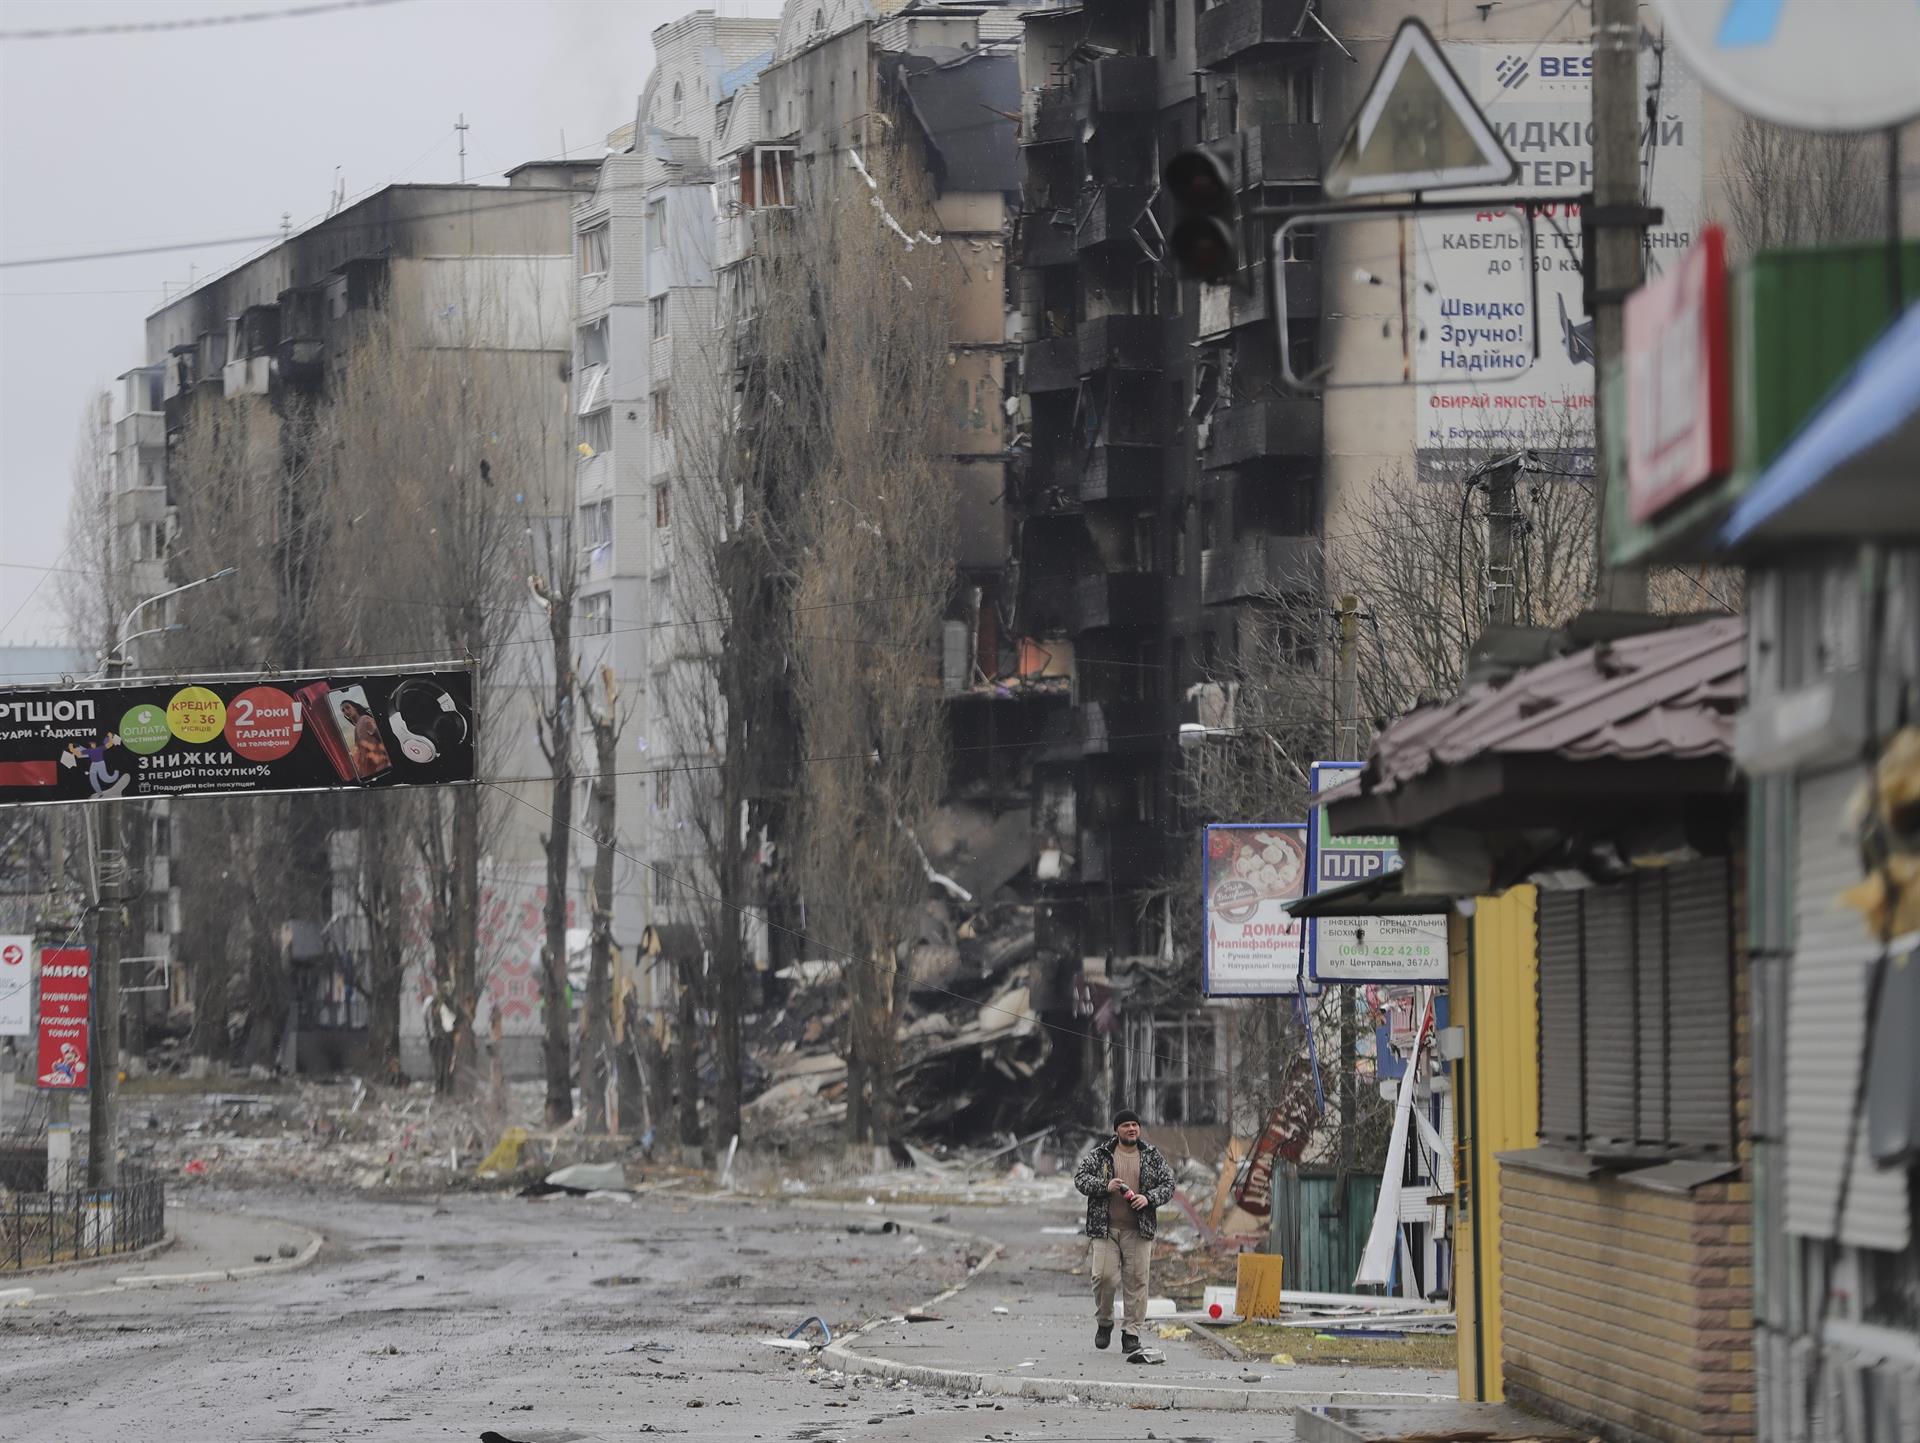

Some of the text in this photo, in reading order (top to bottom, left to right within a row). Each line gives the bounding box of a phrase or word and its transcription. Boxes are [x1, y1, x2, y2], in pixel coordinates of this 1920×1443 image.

[1540, 56, 1593, 77] BES
[1487, 259, 1511, 275] до
[1440, 298, 1525, 319] Швидко
[1440, 324, 1523, 346] Зручно!
[1430, 392, 1491, 409] ОБИРАЙ
[1494, 394, 1546, 410] ЯКІСТЬ
[171, 701, 220, 712] КРЕДИТ
[235, 699, 255, 726] 2
[183, 714, 191, 724] 3
[199, 714, 216, 725] 36
[41, 728, 97, 738] ГАДЖЕТИ
[123, 725, 168, 736] ОПЛАТА
[236, 726, 290, 739] ГАРАНТІЇ
[249, 740, 290, 748] телефони
[138, 752, 233, 769] ЗНИЖКИ
[148, 767, 195, 779] ПЕРШОЇ
[1323, 854, 1381, 877] ПЛР
[1328, 918, 1369, 928] ІНФЕКЦІЯ
[1328, 929, 1366, 937] БІОХІМЯ
[1373, 945, 1394, 956] 422
[1398, 945, 1414, 956] 42
[42, 965, 88, 978] МАРІО
